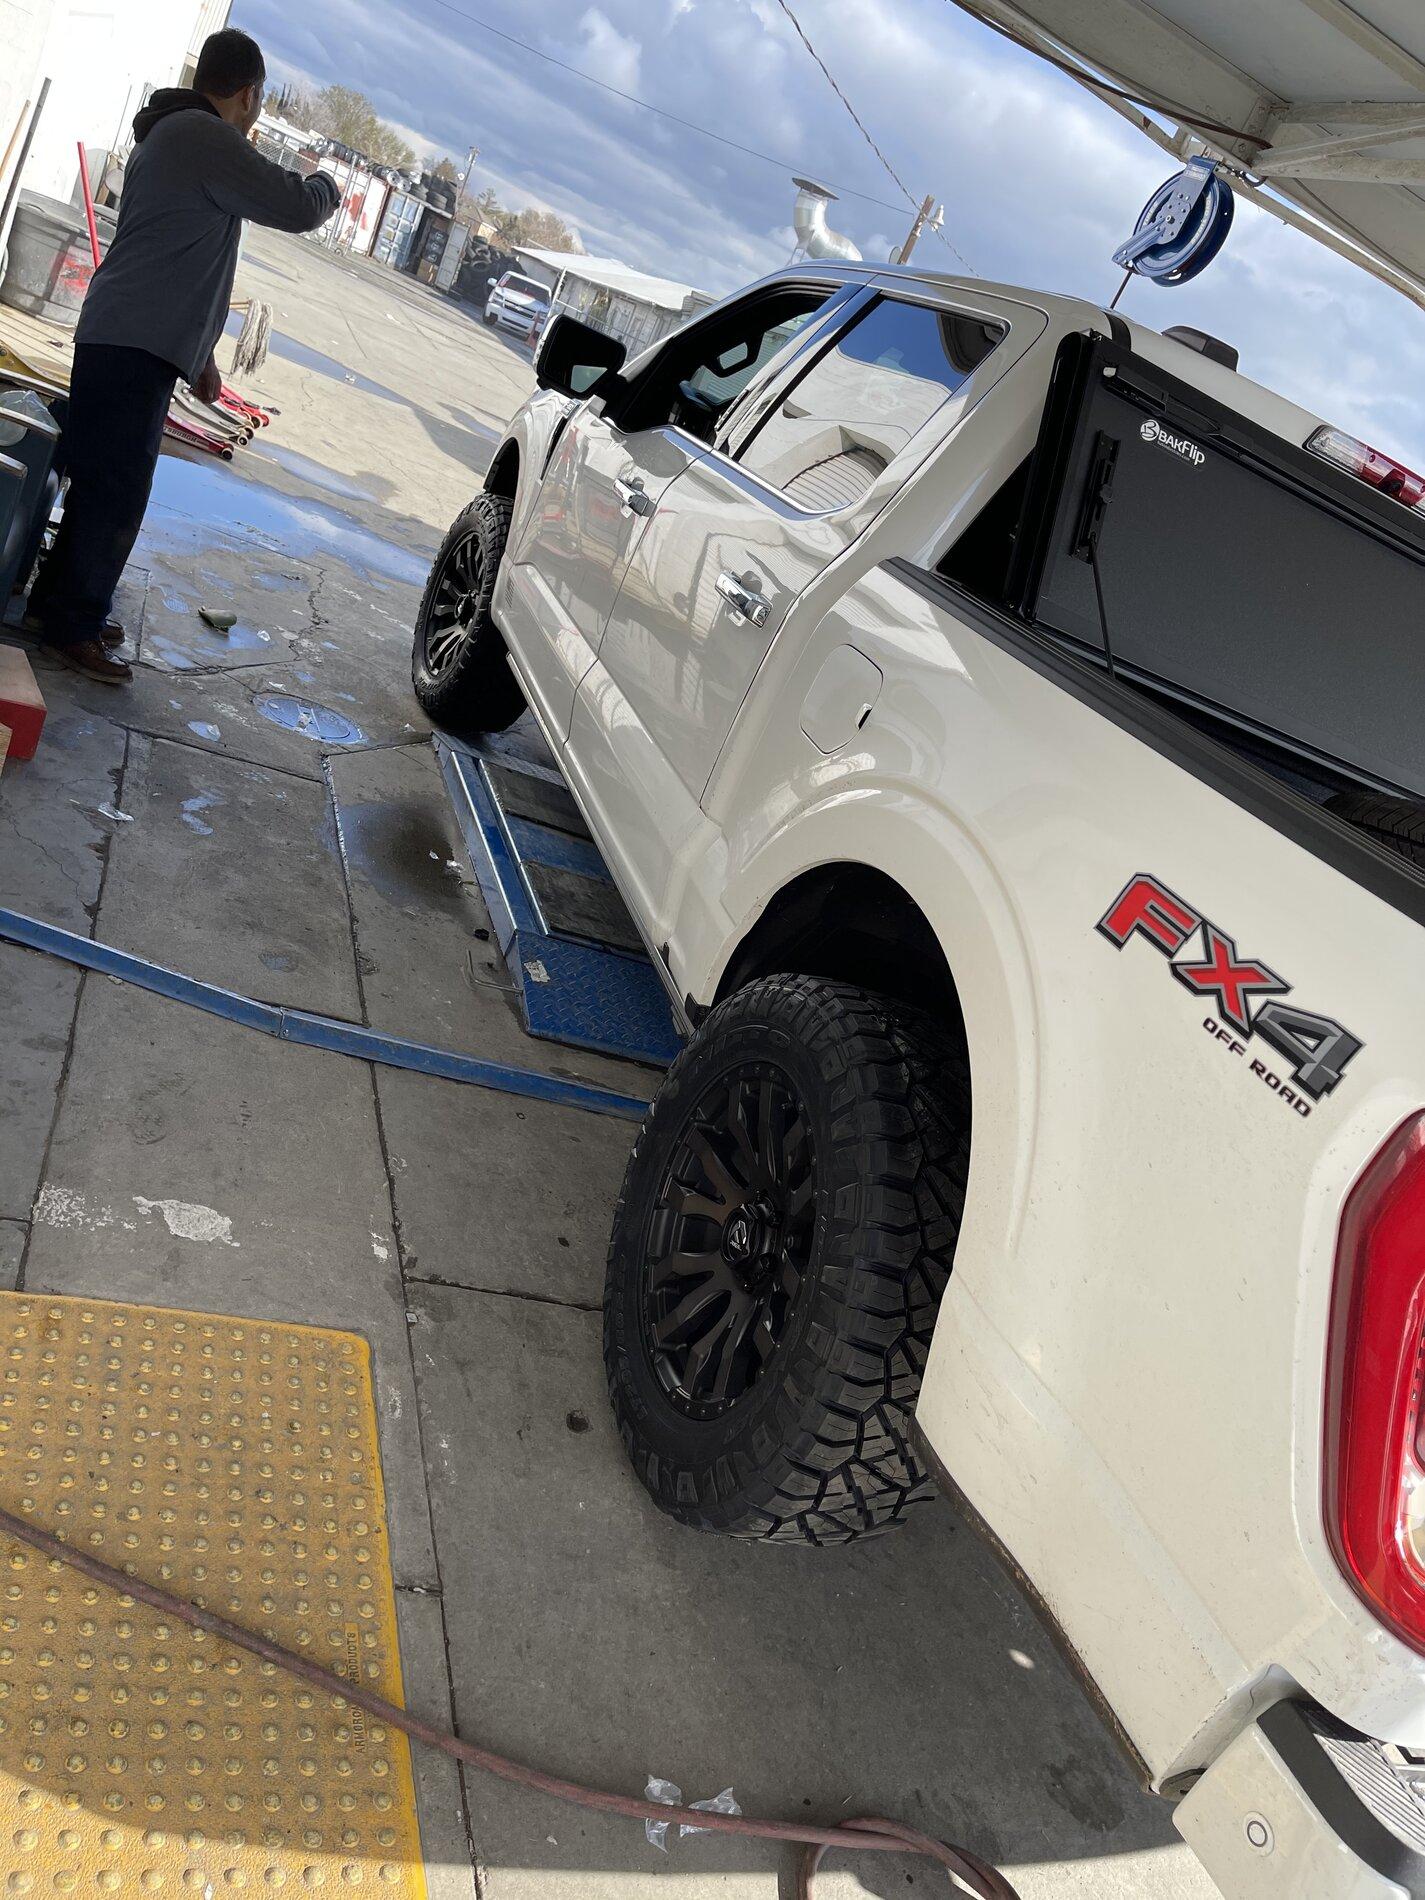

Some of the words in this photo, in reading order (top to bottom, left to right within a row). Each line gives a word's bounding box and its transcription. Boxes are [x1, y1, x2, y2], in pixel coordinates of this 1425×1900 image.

[1093, 872, 1366, 1104] FX4
[1202, 1016, 1247, 1057] OFF
[1248, 1057, 1312, 1118] ROAD
[346, 1632, 360, 1685] PRODUCTS
